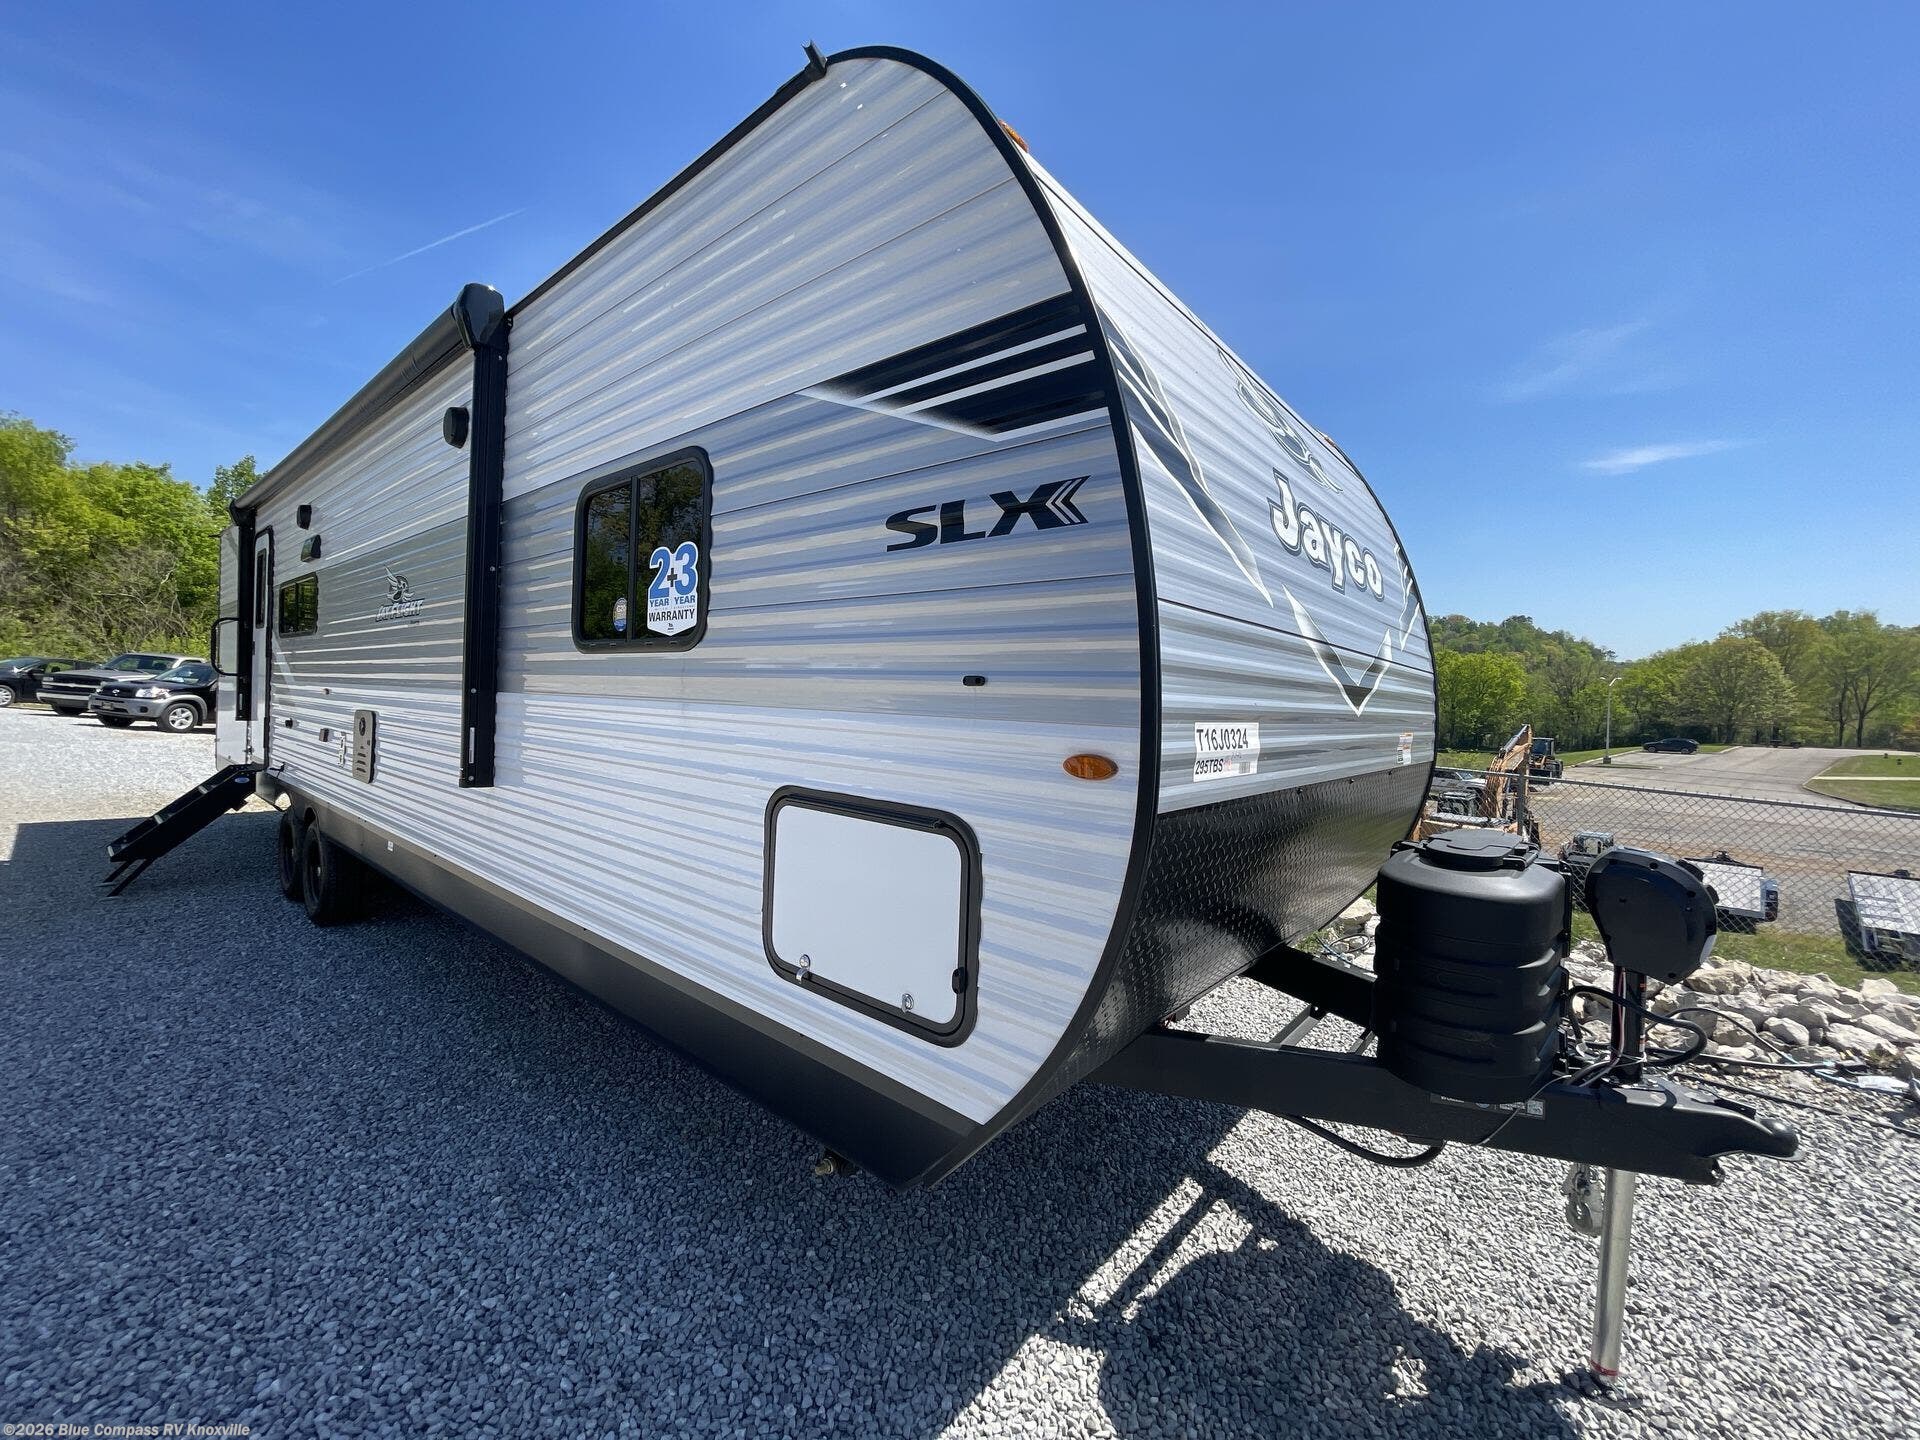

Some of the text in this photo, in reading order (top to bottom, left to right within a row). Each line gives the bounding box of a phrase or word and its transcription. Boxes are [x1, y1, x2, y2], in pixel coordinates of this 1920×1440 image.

[885, 475, 1091, 552] SLX
[1266, 467, 1384, 602] Jayco
[649, 595, 696, 608] YEAR YEAR
[648, 608, 695, 622] WARRANTY
[1196, 728, 1249, 752] T16J0324
[1195, 758, 1224, 775] 295TBS
